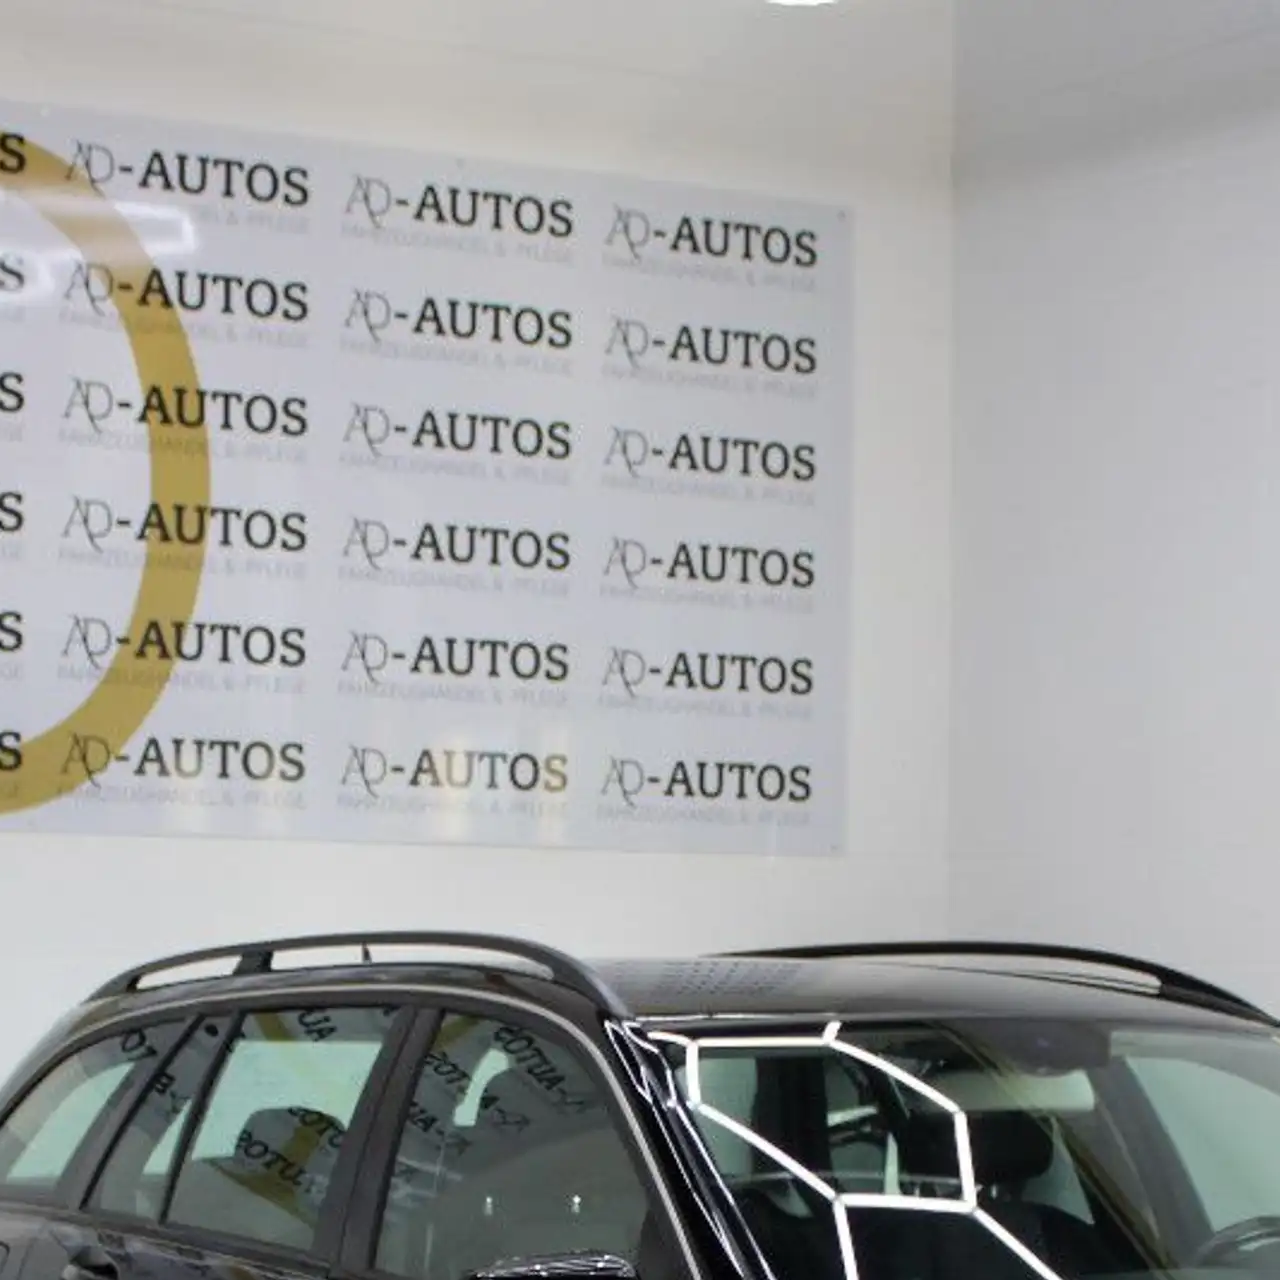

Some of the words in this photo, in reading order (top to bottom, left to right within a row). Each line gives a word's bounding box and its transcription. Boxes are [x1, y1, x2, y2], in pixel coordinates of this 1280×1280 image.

[62, 139, 308, 207] AD-AUTOS
[344, 175, 573, 238] AD-AUTOS
[602, 204, 818, 267] AD-AUTOS
[62, 261, 308, 320] AD-AUTOS
[344, 289, 573, 348] AD-AUTOS
[602, 317, 817, 374] AD-AUTOS
[62, 377, 308, 435] AD-AUTOS
[344, 403, 573, 459] AD-AUTOS
[602, 427, 816, 481] AD-AUTOS
[62, 496, 308, 553] AD-AUTOS
[343, 517, 570, 571] AD-AUTOS
[602, 537, 815, 588] AD-AUTOS
[62, 614, 308, 670] AD-AUTOS
[343, 632, 568, 683] AD-AUTOS
[602, 647, 814, 698] AD-AUTOS
[62, 732, 308, 788] AD-AUTOS
[343, 746, 567, 798] AD-AUTOS
[602, 757, 812, 807] AD-AUTOS
